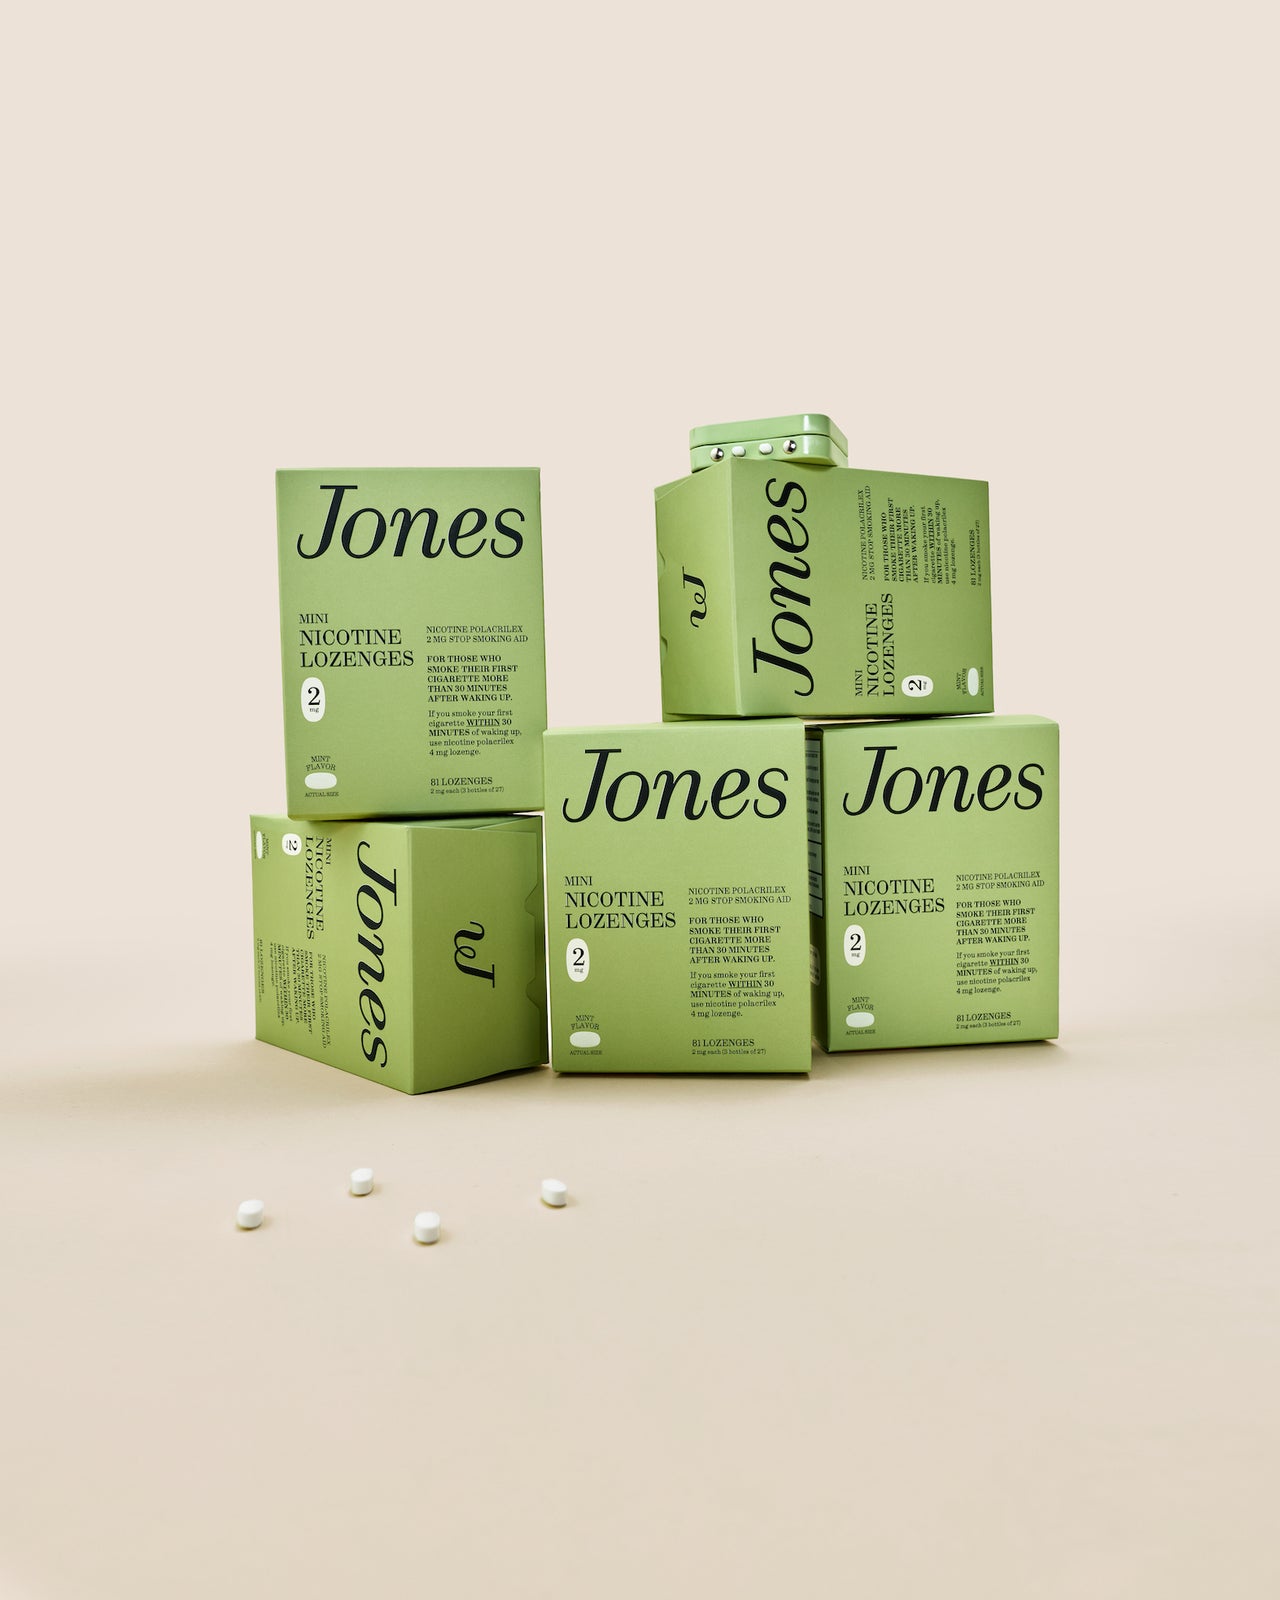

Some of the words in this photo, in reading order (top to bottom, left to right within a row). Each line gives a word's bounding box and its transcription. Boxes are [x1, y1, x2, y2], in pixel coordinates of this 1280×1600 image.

[297, 485, 525, 560] Jones
[753, 478, 815, 697] Jones
[300, 614, 328, 624] MINI
[300, 629, 402, 646] NICOTINE
[881, 594, 896, 696] LOZENGES
[865, 604, 880, 696] NICOTINE
[301, 651, 414, 668] LOZENGES
[855, 670, 863, 696] MINI
[908, 680, 922, 691] 2
[308, 687, 321, 706] 2
[467, 719, 500, 727] WITHIN
[477, 738, 514, 747] polacrilex
[306, 763, 336, 772] FLAVOR
[442, 777, 493, 786] LOZENGES
[562, 749, 789, 824] Jones
[843, 746, 1045, 816] Jones
[288, 840, 298, 851] 2
[844, 866, 870, 876] MINI
[956, 874, 993, 882] NICOTINE
[994, 871, 1041, 880] POLACRILEX
[305, 836, 315, 940] LOZENGES
[316, 836, 324, 932] NICOTINE
[565, 876, 592, 886] MINI
[844, 878, 934, 897] NICOTINE
[732, 886, 786, 894] POLACRILEX
[565, 891, 664, 908] NICOTINE
[845, 898, 945, 917] LOZENGES
[566, 912, 676, 929] LOZENGES
[956, 919, 1002, 927] CIGARETTE
[850, 934, 861, 951] 2
[357, 840, 397, 1068] Jones
[573, 948, 585, 966] 2
[729, 980, 762, 988] WITHIN
[739, 1000, 777, 1009] polacrilex
[966, 1012, 1011, 1022] LOZENGES
[571, 1022, 600, 1031] FLAVOR
[703, 1039, 755, 1047] LOZENGES
